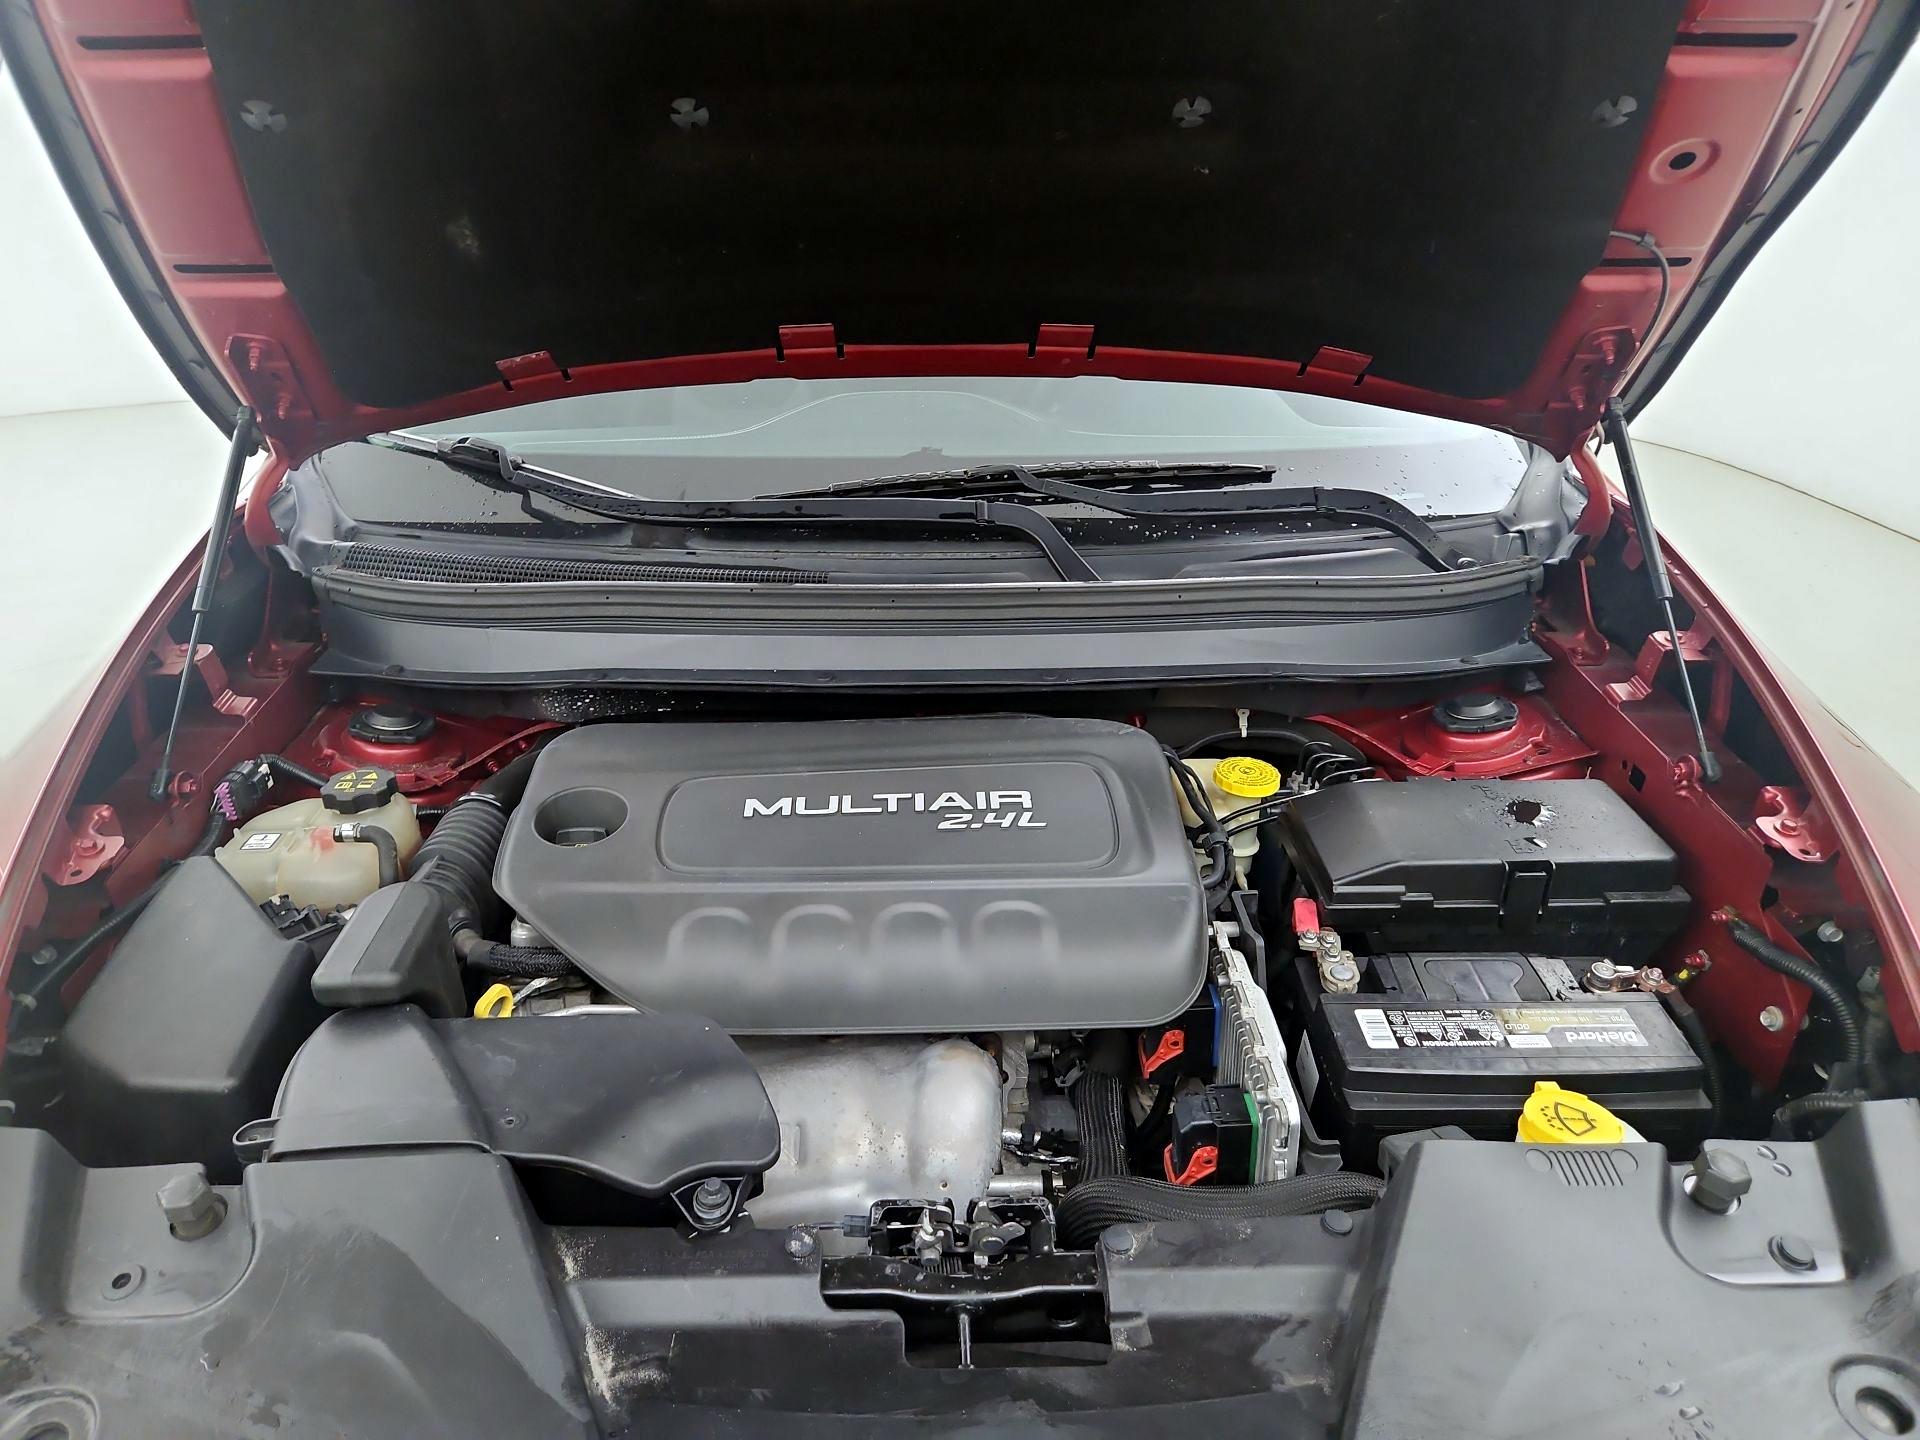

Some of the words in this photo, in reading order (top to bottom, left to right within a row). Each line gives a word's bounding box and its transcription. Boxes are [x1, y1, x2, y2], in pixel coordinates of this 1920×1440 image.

[743, 790, 1033, 817] MULTIAIR
[937, 811, 1048, 830] 2.4L
[1564, 1031, 1640, 1043] DieHard
